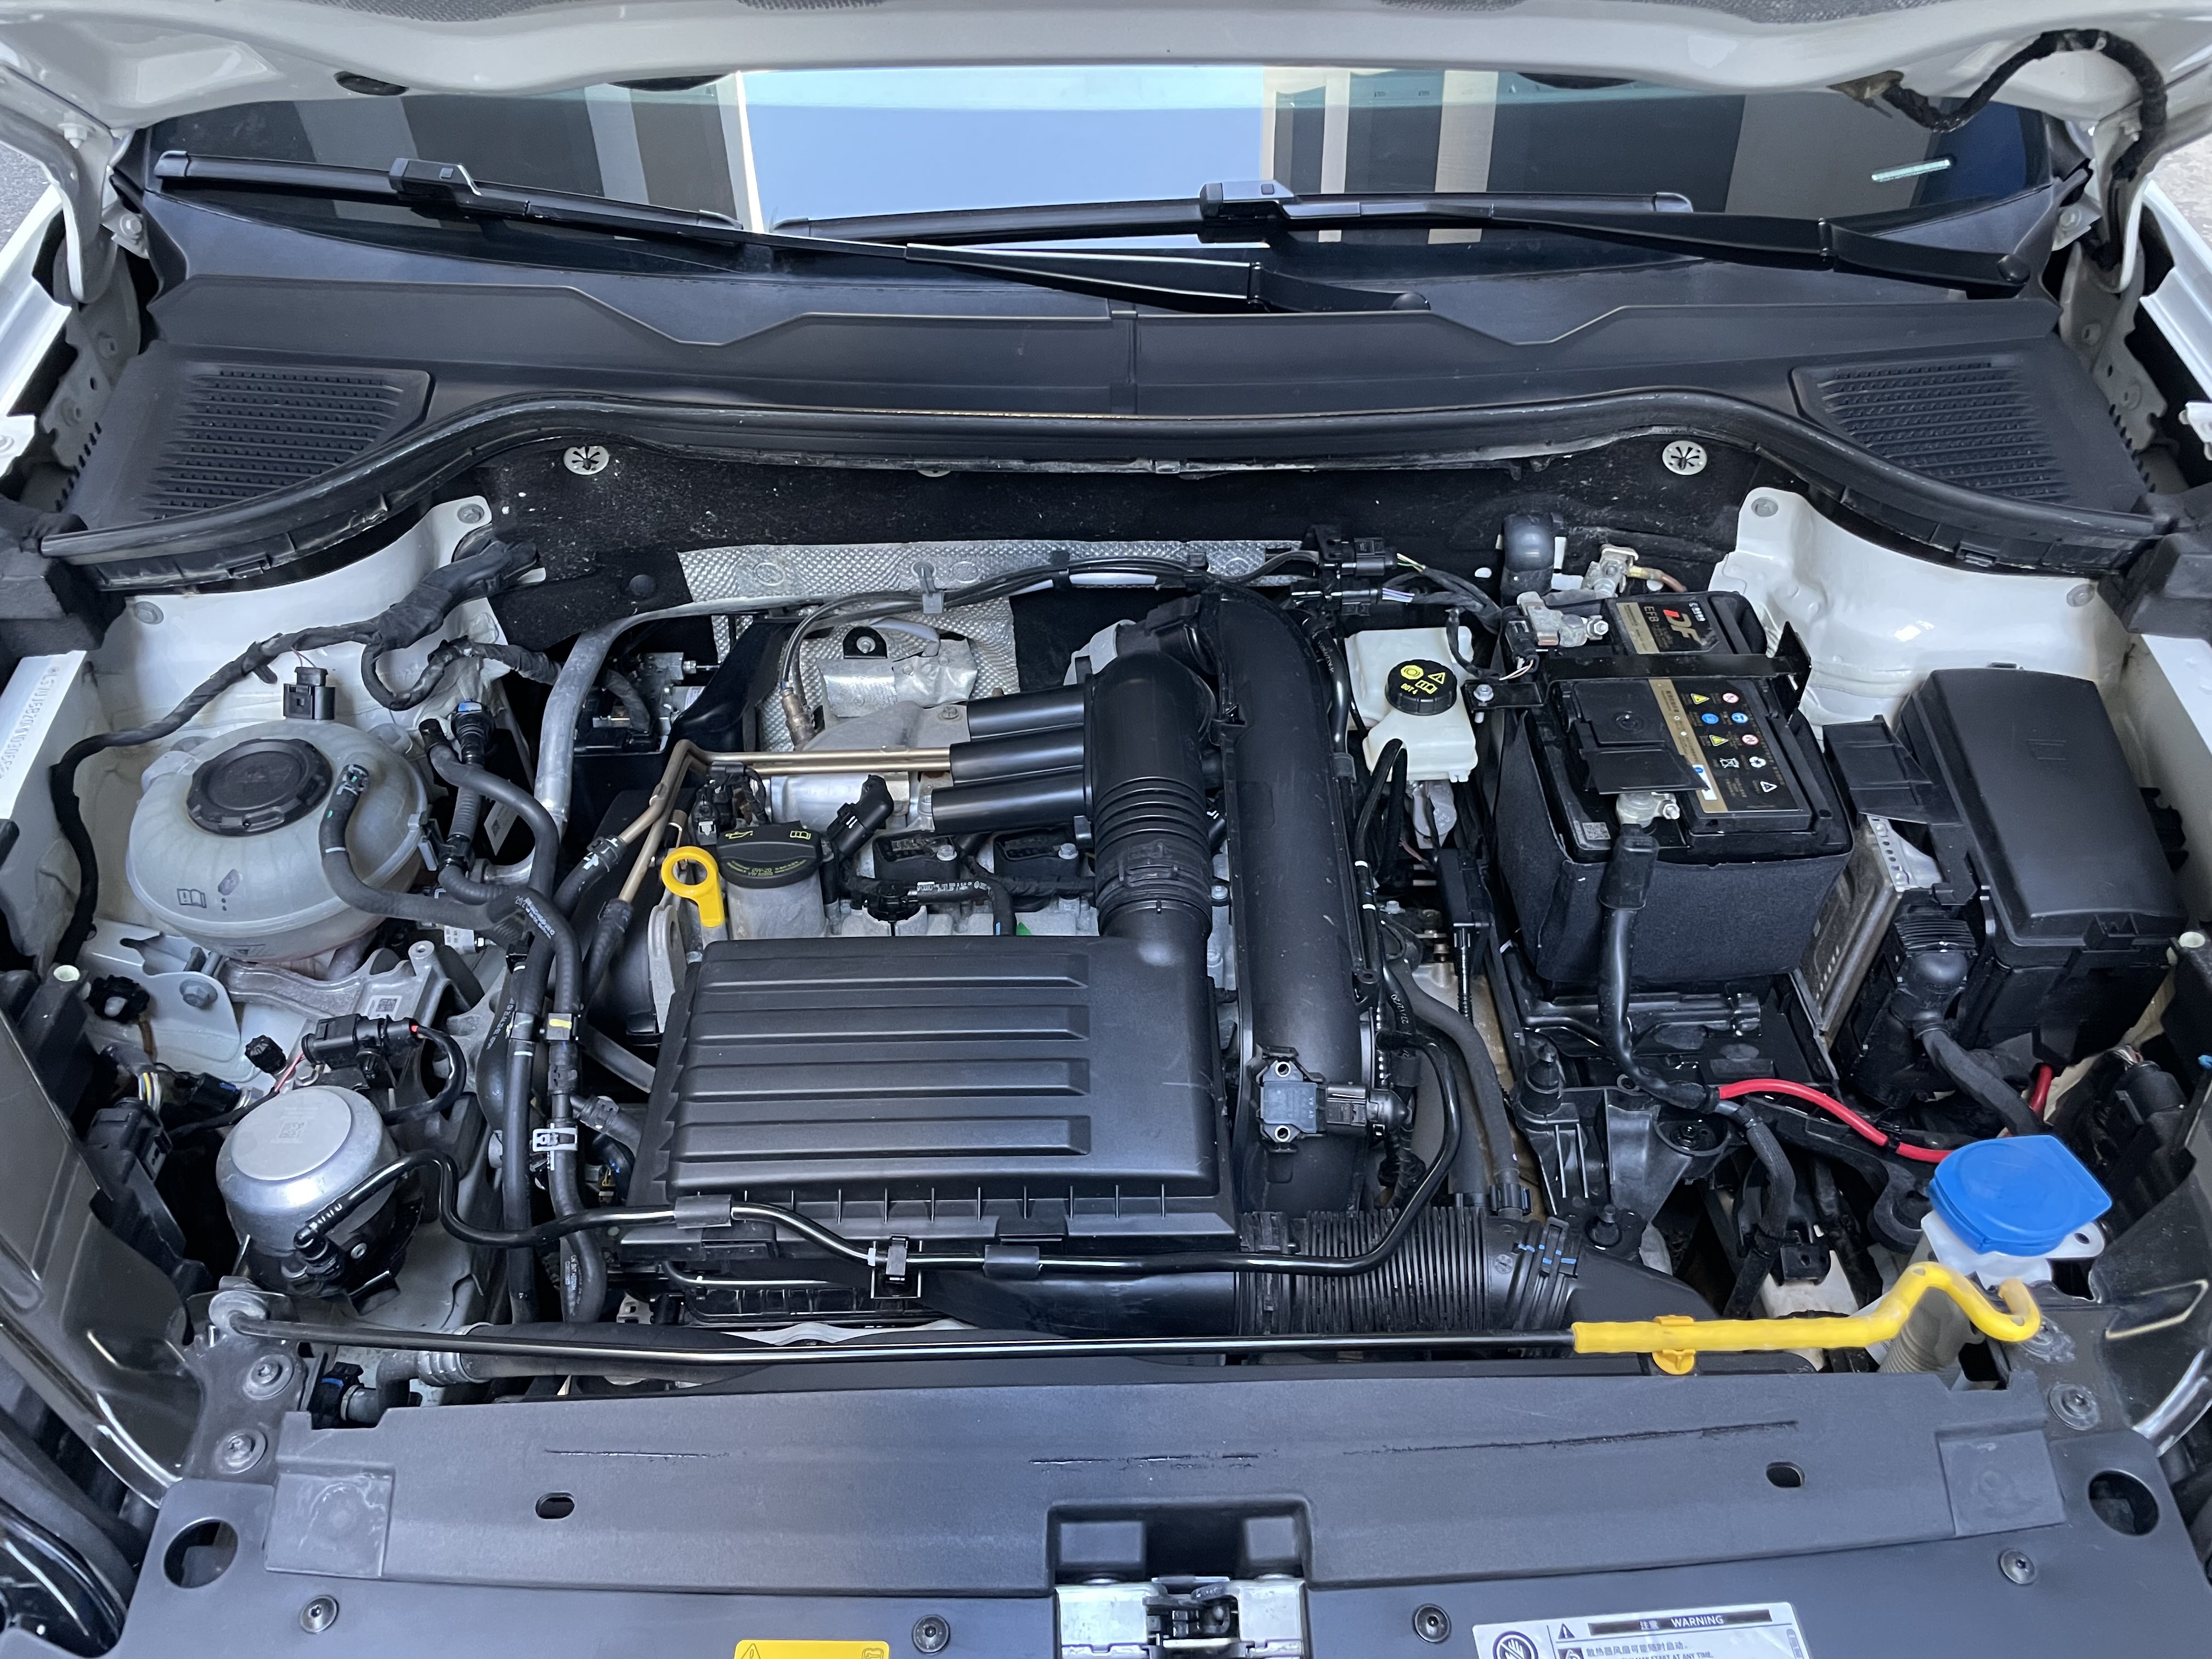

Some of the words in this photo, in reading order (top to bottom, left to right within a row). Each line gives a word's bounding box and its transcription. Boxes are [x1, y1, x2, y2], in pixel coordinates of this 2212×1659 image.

[1644, 606, 1659, 622] EFB
[1391, 994, 1409, 1024] 27/12/20
[1669, 1615, 1724, 1628] WARNING
